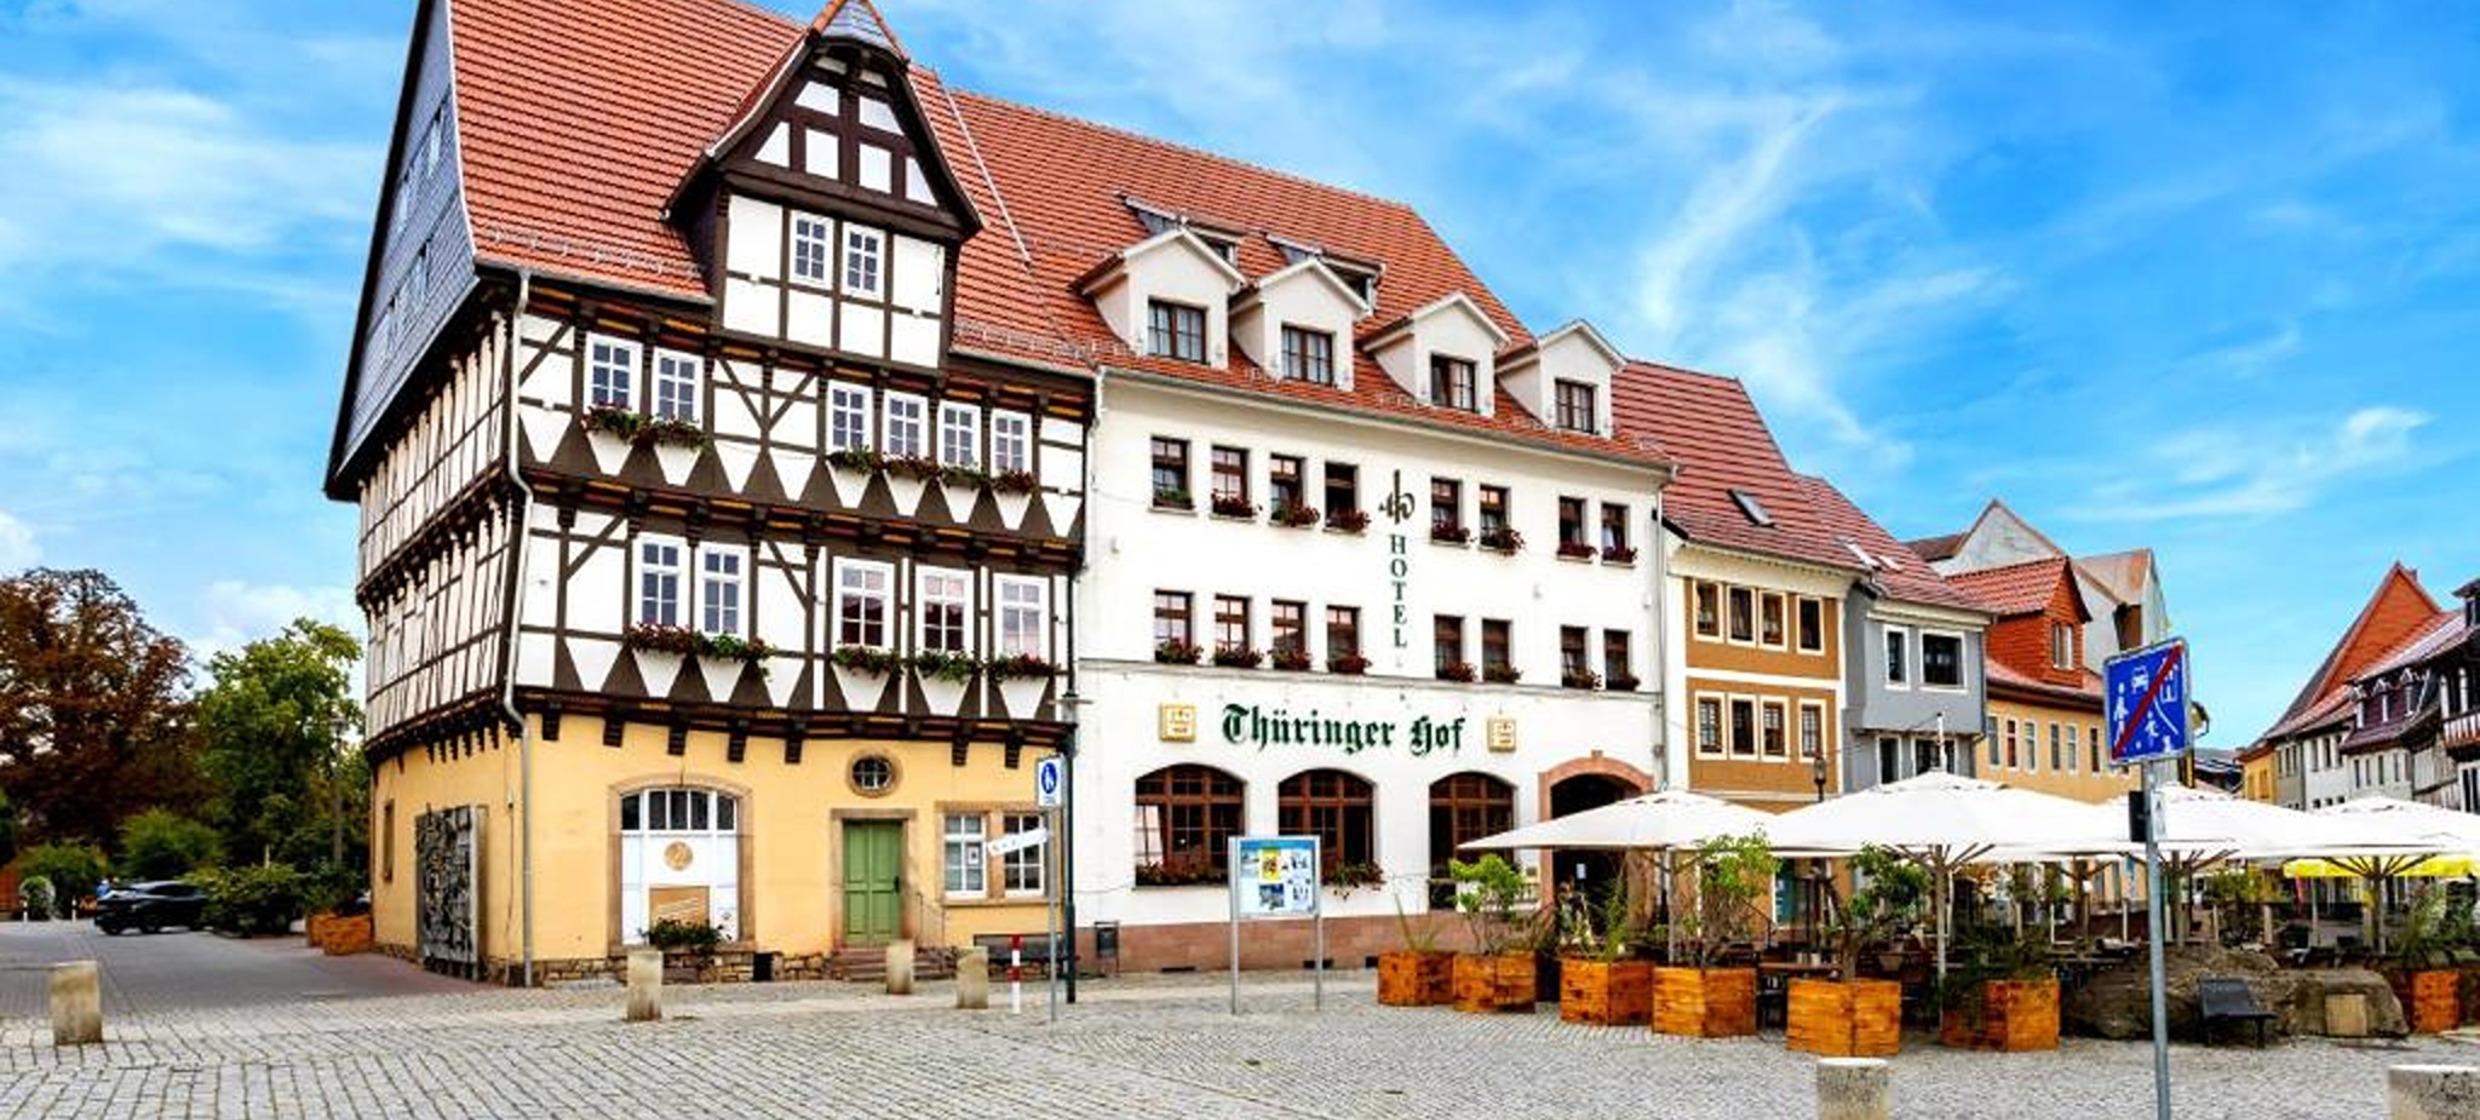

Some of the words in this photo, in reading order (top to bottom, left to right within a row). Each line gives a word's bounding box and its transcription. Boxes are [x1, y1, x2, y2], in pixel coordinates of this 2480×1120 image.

[1389, 533, 1408, 648] HOTEL
[1222, 703, 1396, 755] Thüringer
[1410, 715, 1466, 756] Hof
